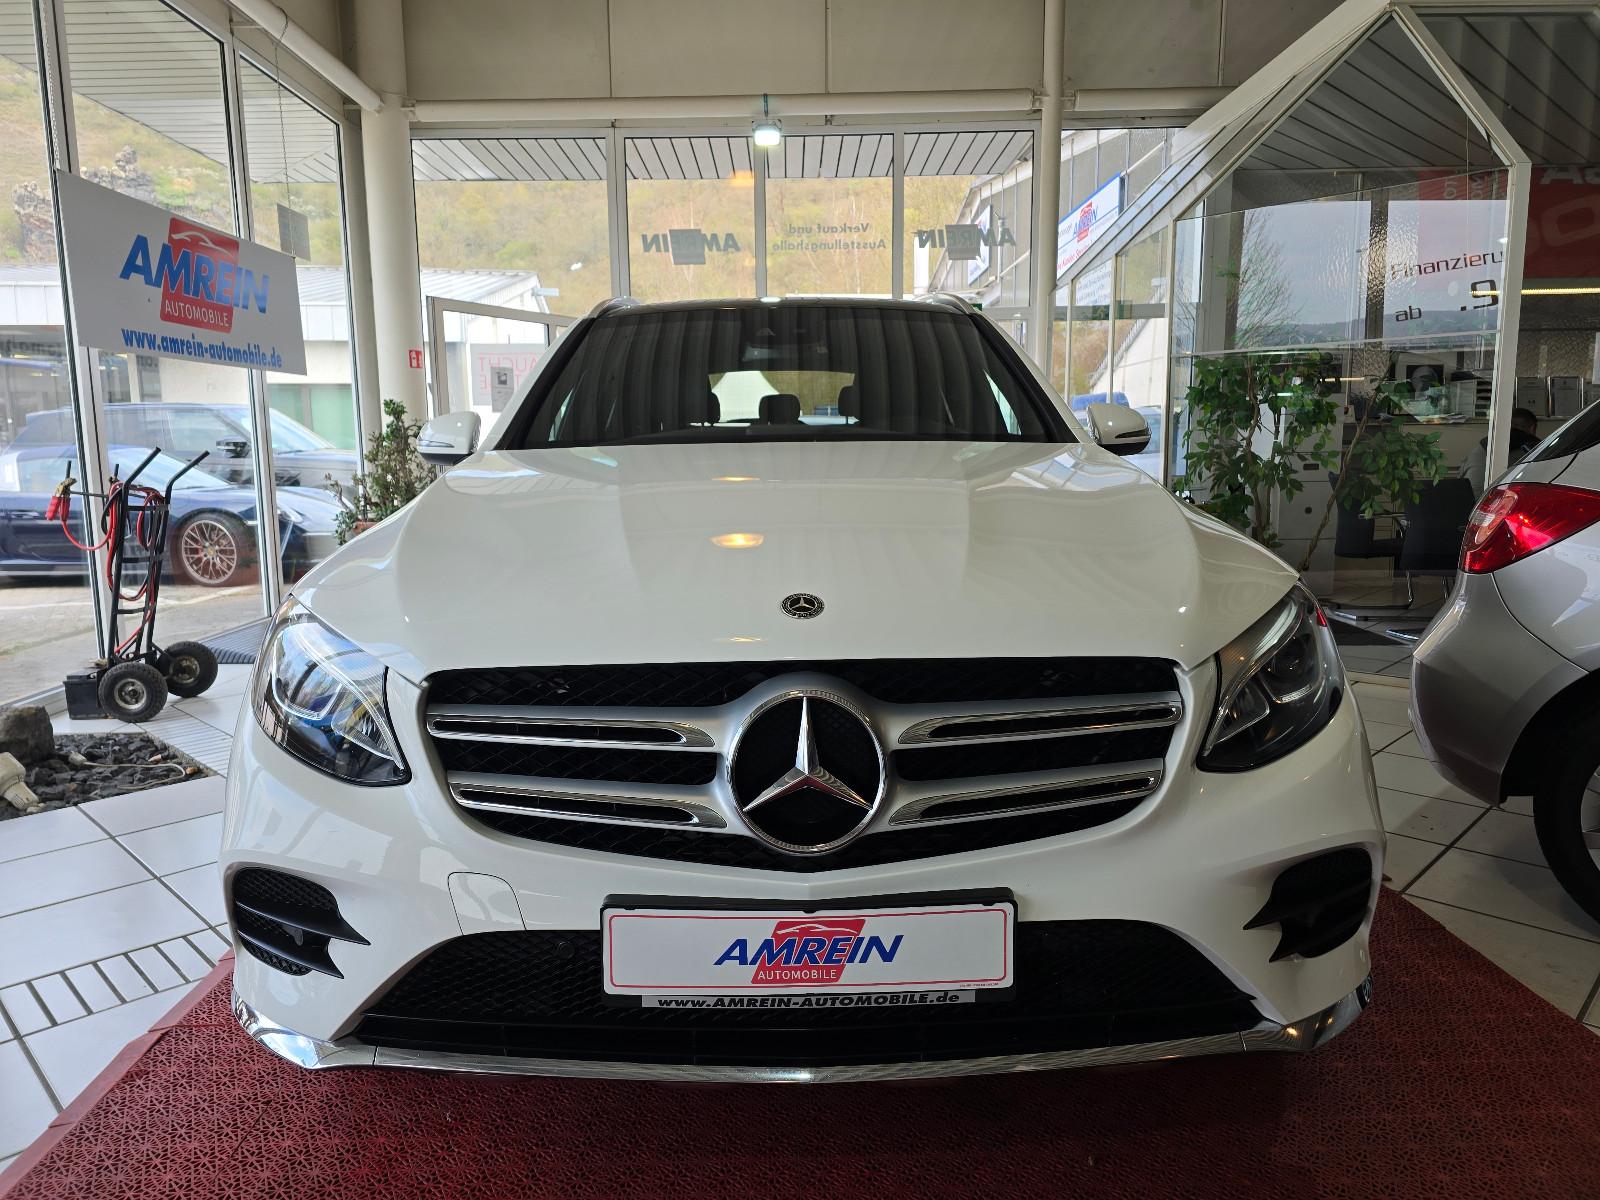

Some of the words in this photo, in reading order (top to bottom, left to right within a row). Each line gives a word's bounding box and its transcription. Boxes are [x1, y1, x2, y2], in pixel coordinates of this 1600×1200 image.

[120, 234, 270, 314] AMREIN
[165, 300, 229, 327] AUTOMOBILE
[1395, 305, 1422, 322] ab
[121, 328, 282, 368] www.amrein-automobile.de
[713, 934, 904, 966] AMREIN
[758, 969, 838, 980] AUTOMOBILE
[658, 991, 961, 1008] www.AMREIN-AUTOMOBILE.de
